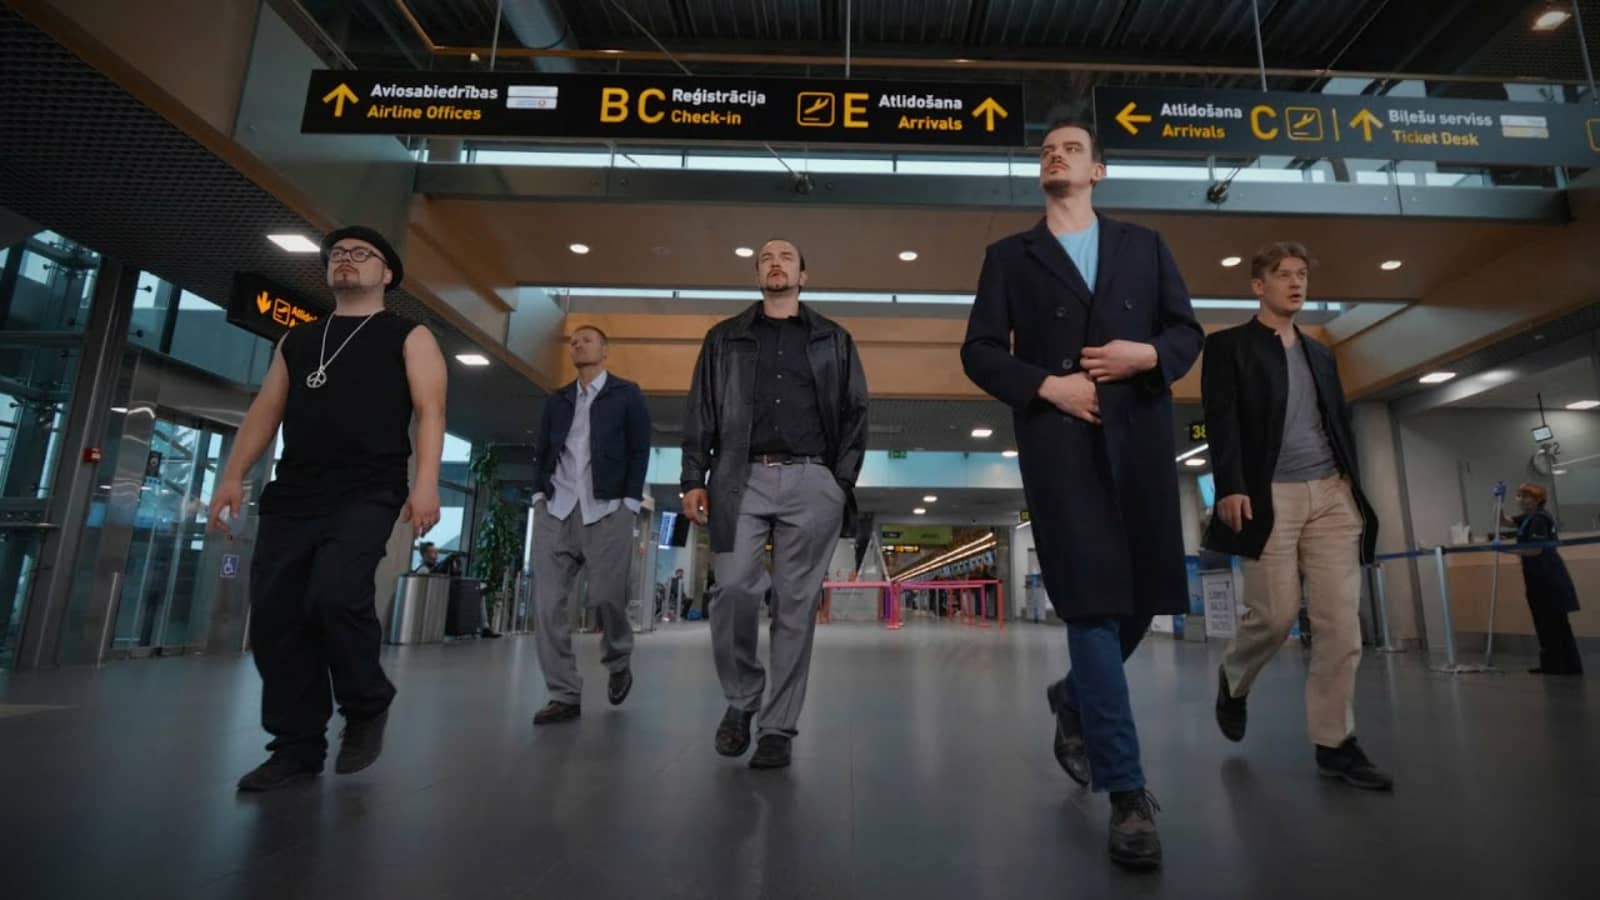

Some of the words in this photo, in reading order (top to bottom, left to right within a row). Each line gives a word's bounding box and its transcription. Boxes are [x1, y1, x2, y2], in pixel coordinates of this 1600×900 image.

[370, 83, 498, 99] Aviosabiedrības
[672, 87, 766, 106] Reģistrācija
[600, 87, 629, 123] B
[638, 88, 666, 124] C
[844, 92, 869, 128] E
[878, 94, 963, 110] Atlidošana
[367, 105, 423, 119] Airline
[426, 106, 482, 120] Offices
[671, 109, 742, 125] Check-in
[1160, 103, 1243, 119] Atlidošana
[1388, 109, 1436, 126] Biļešu
[1438, 112, 1494, 127] serviss
[898, 115, 963, 131] Arrivals
[1251, 105, 1279, 140] C
[1162, 123, 1226, 139] Arrivals
[1391, 129, 1439, 145] Ticket
[1440, 131, 1480, 146] Desk
